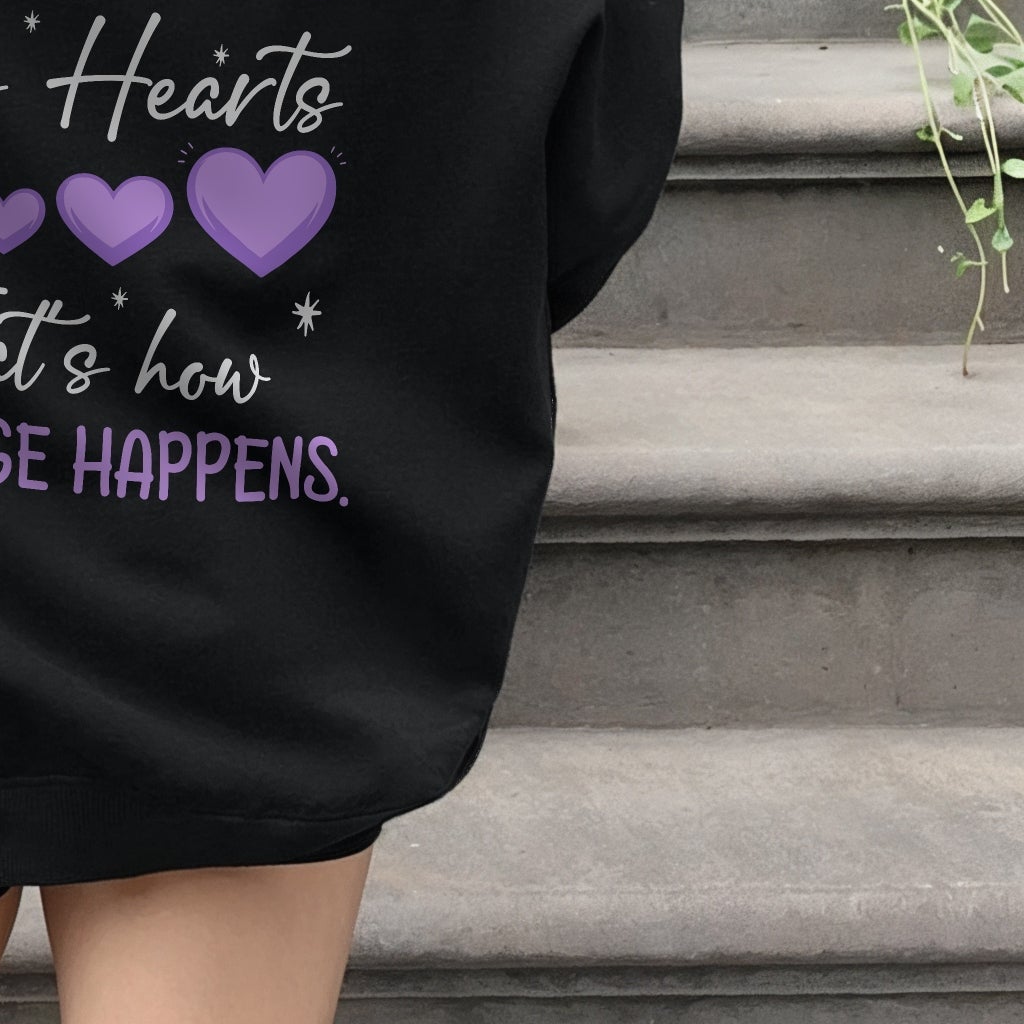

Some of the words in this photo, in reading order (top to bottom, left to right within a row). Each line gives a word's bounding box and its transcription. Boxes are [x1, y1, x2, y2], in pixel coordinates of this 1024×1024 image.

[45, 11, 353, 143] Hearts
[134, 307, 272, 405] how
[72, 424, 349, 507] HAPPENS.
